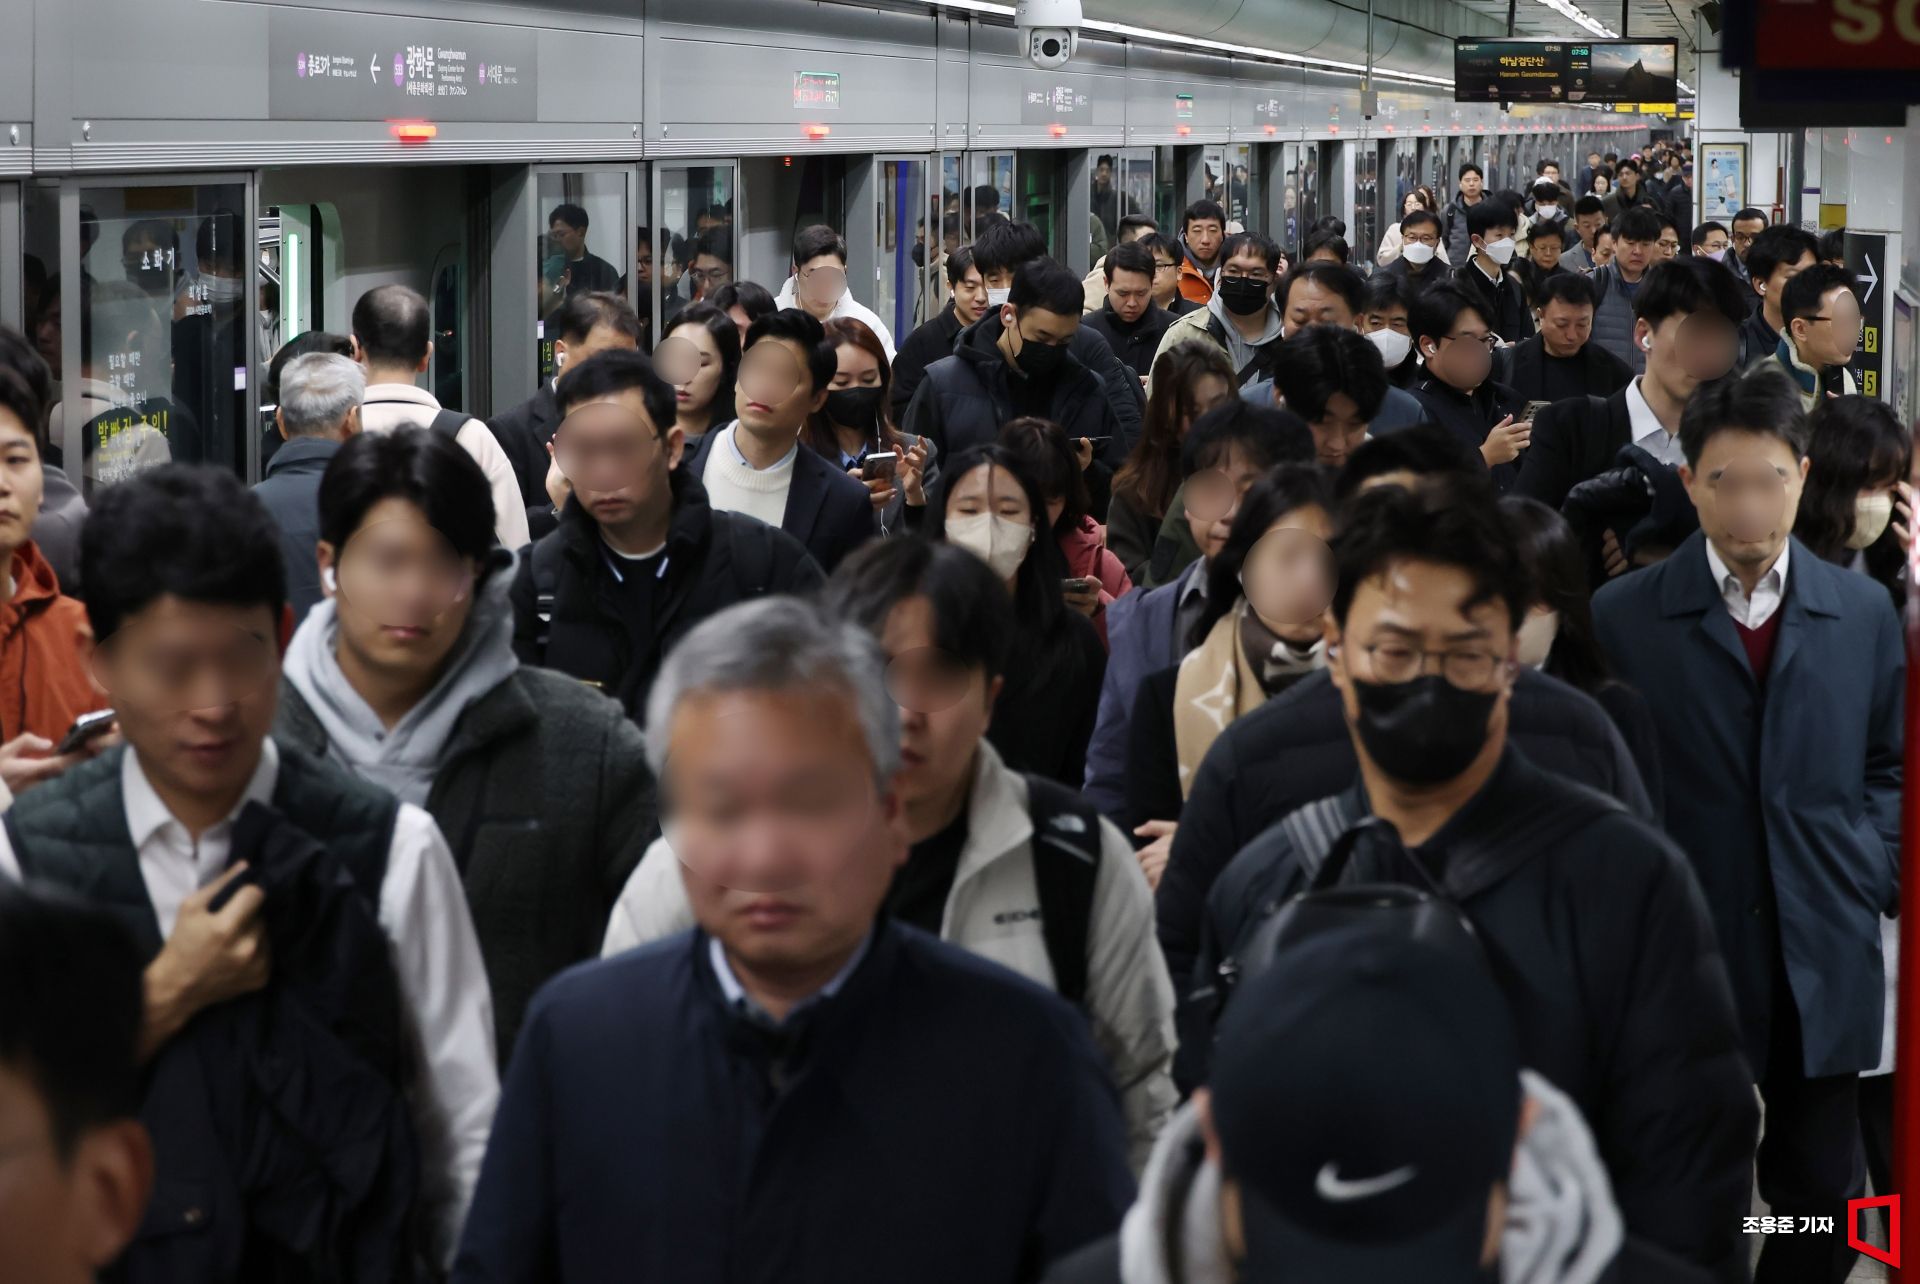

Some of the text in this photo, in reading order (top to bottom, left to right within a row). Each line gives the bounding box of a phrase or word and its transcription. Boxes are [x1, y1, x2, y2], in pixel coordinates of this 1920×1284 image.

[308, 54, 330, 77] 종로3가
[406, 44, 435, 79] 광화문
[1499, 56, 1545, 67] 하남검단산
[141, 247, 174, 271] 소화기
[1867, 331, 1874, 348] 9
[1866, 375, 1873, 391] 5
[98, 415, 132, 448] 발빠짐
[139, 410, 167, 440] 주의!
